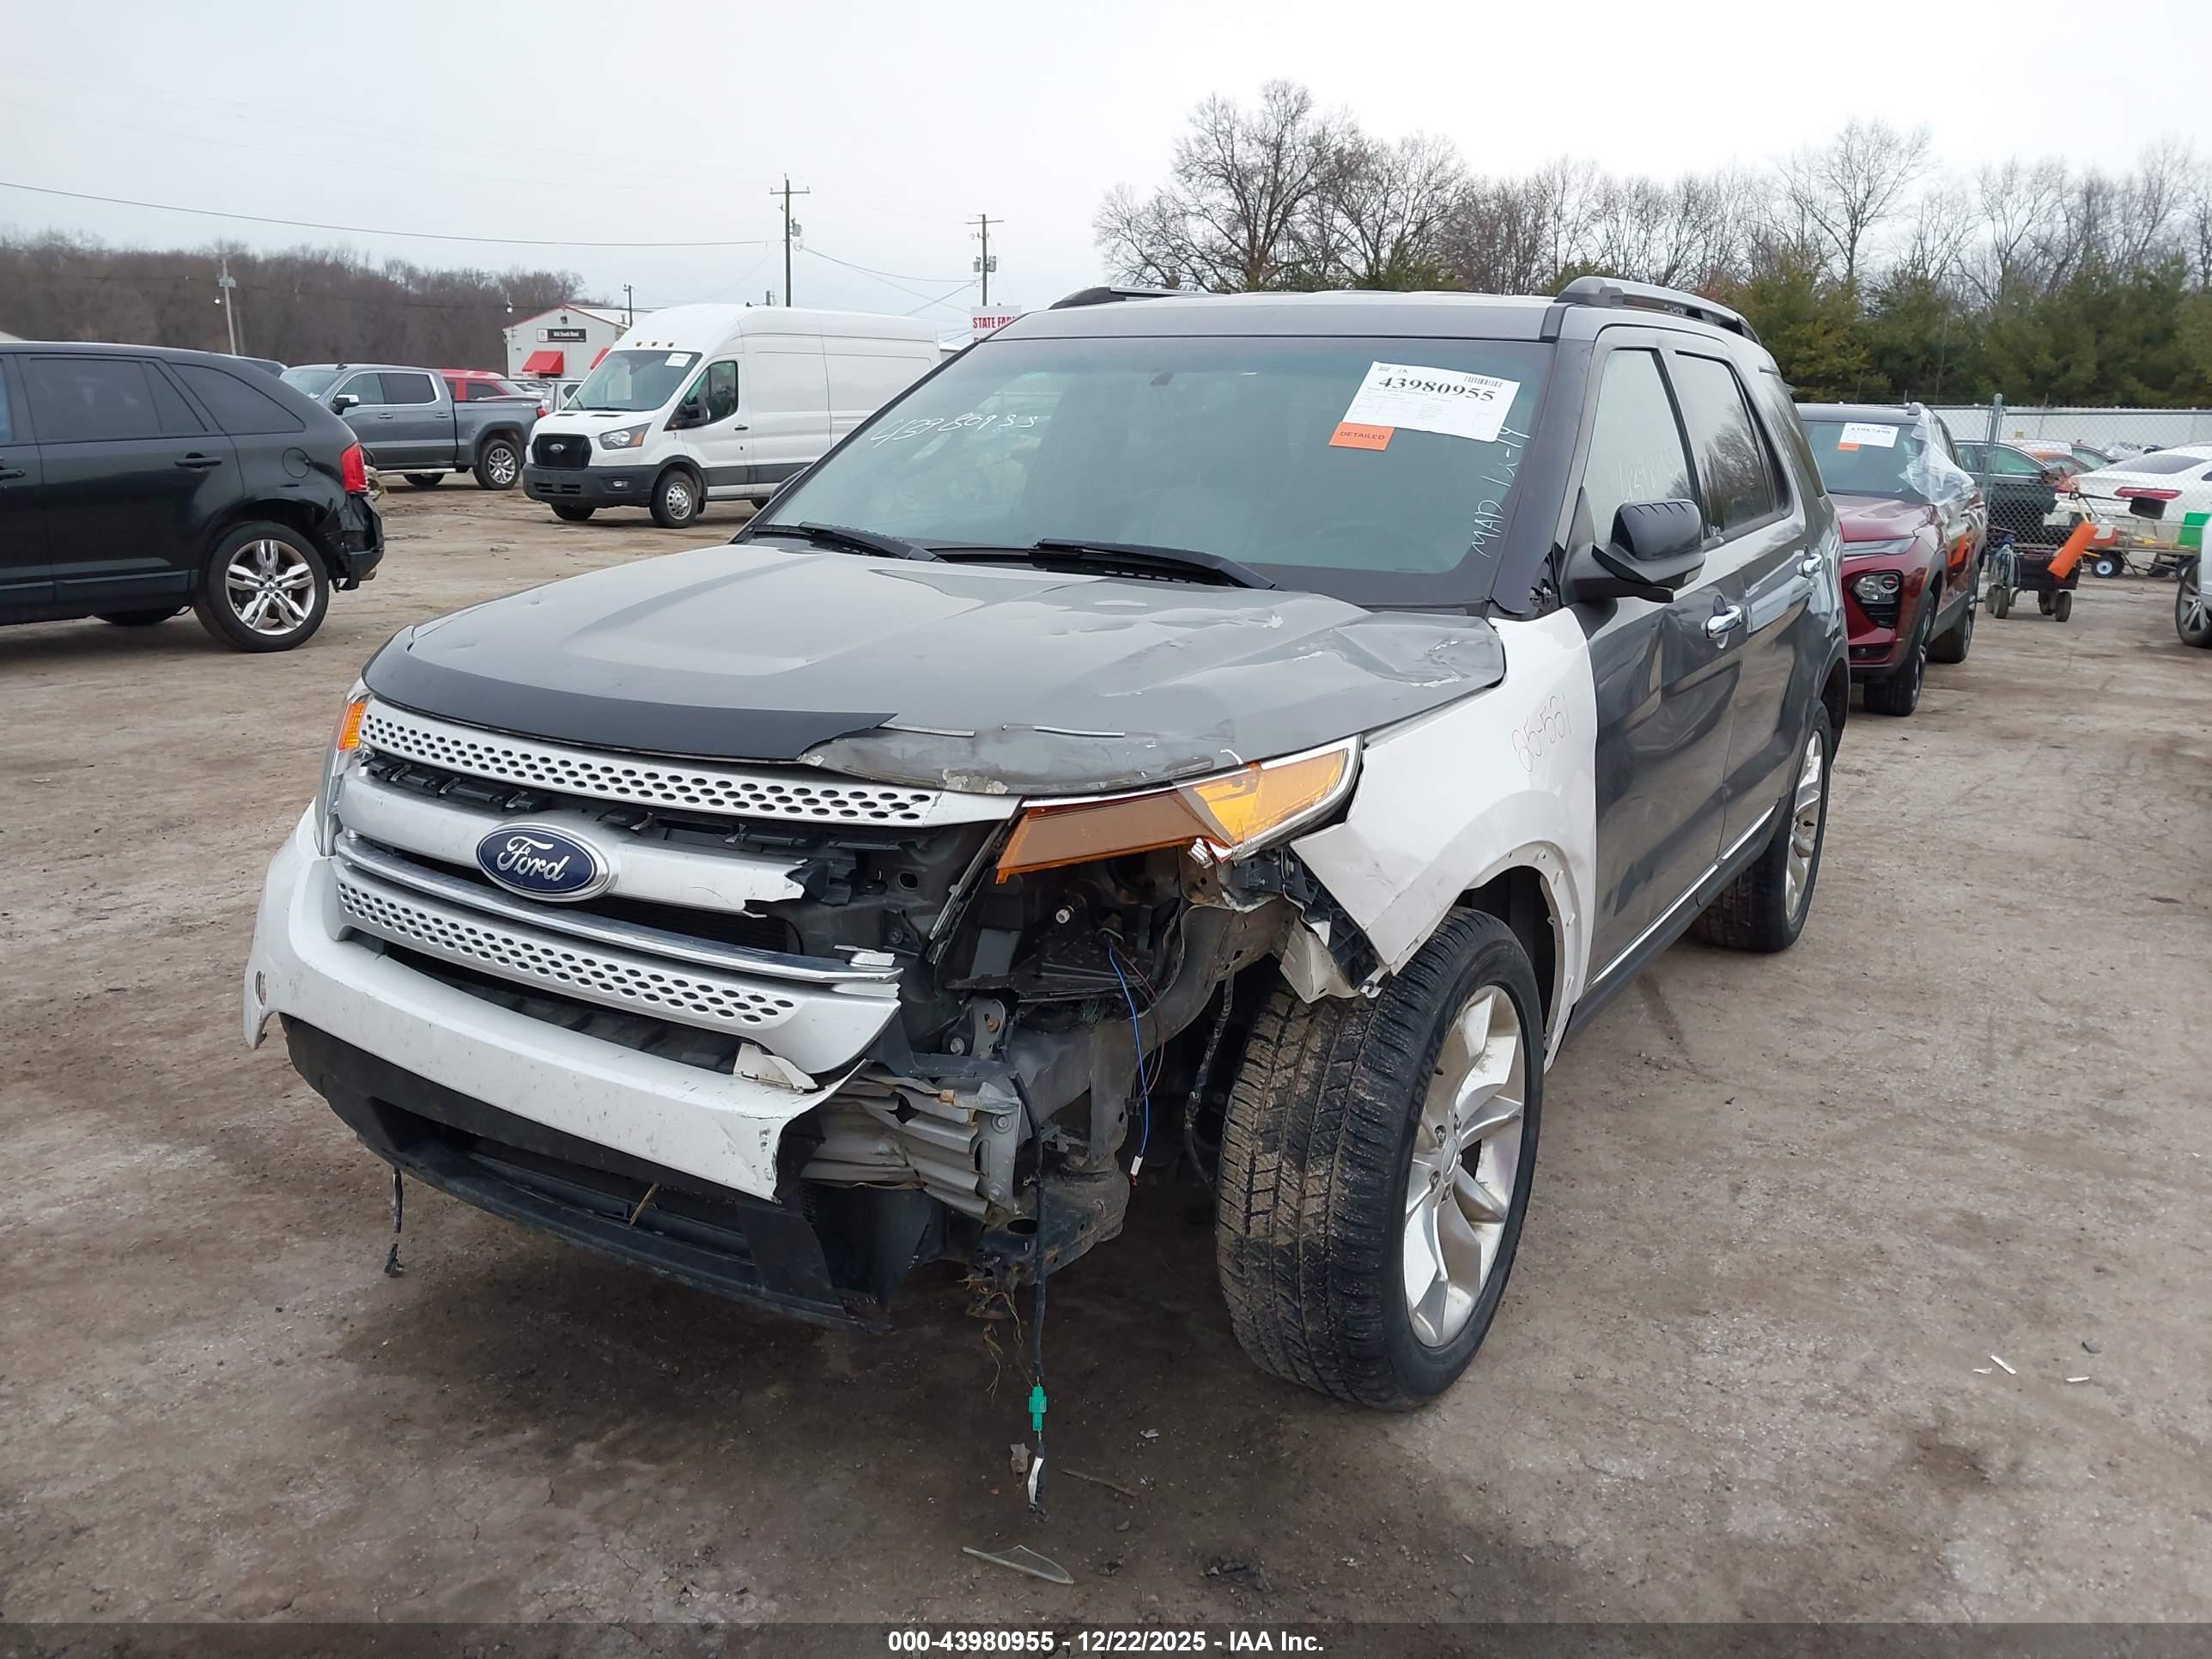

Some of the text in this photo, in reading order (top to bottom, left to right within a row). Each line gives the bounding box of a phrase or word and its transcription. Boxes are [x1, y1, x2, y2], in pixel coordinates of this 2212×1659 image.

[972, 317, 996, 328] STATE
[1378, 375, 1497, 402] 43980955
[1340, 430, 1385, 441] DETAILED
[1471, 499, 1504, 558] MAD
[496, 836, 570, 882] Ford
